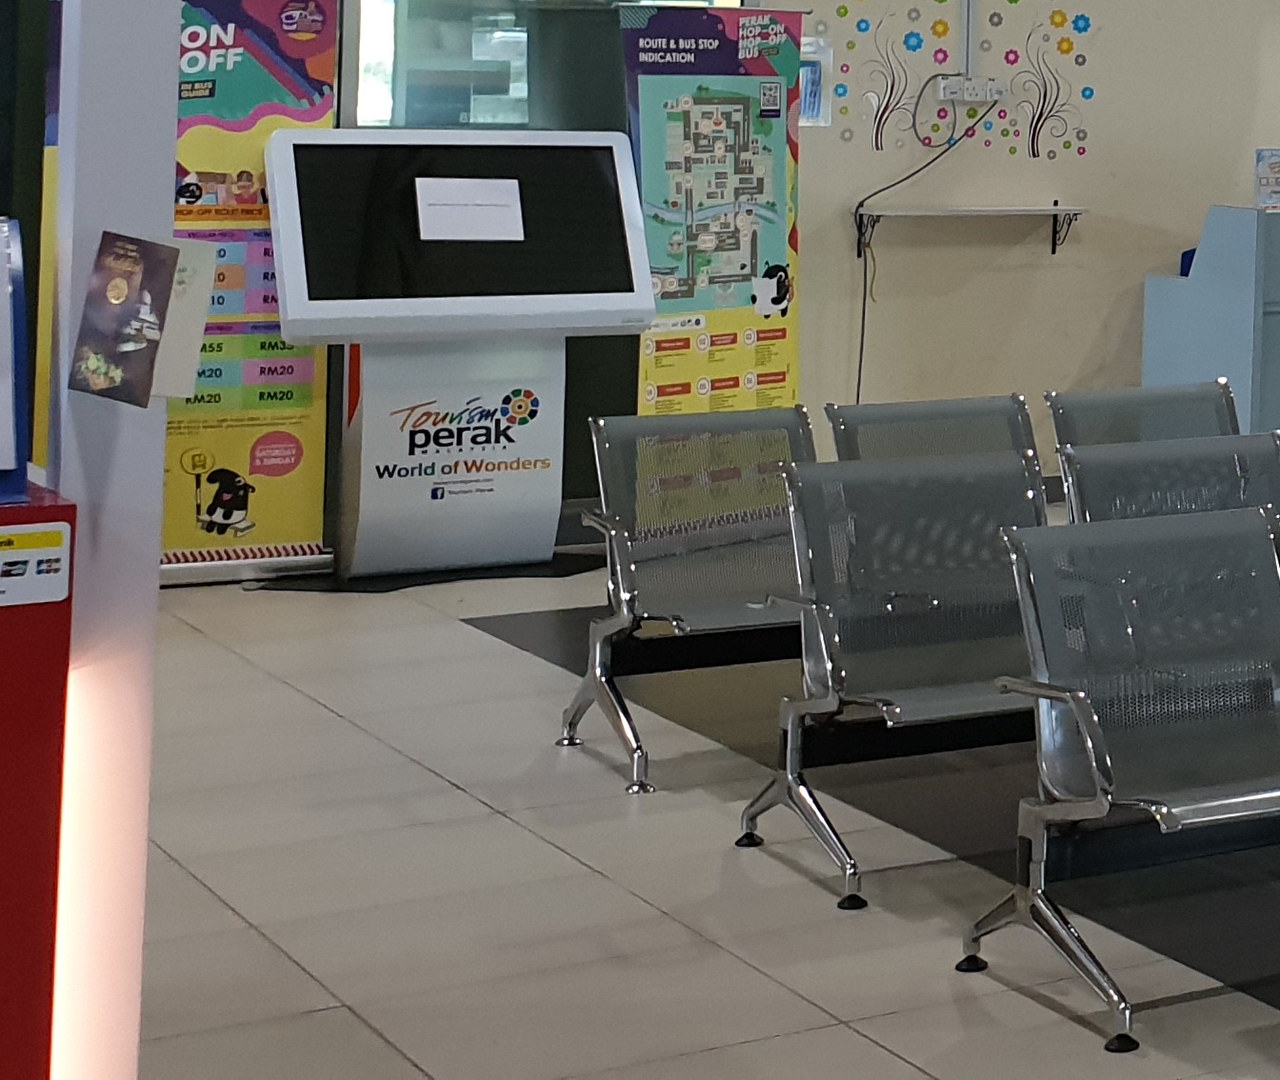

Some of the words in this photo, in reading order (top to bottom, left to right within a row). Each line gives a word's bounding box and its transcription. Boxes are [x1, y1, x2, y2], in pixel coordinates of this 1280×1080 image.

[739, 14, 771, 27] PERAK
[180, 23, 236, 49] ON
[639, 38, 667, 49] ROUTE
[670, 39, 677, 49] &
[679, 39, 696, 49] BUS
[698, 39, 720, 50] STOP
[639, 52, 695, 63] INDICATION
[738, 47, 759, 59] BUS
[180, 47, 244, 74] OFF
[259, 365, 294, 377] RM20
[259, 390, 294, 401] RM20
[390, 396, 498, 433] Tourism
[408, 418, 516, 456] perak
[375, 462, 436, 479] World
[441, 460, 460, 475] of
[464, 457, 551, 474] Wonders
